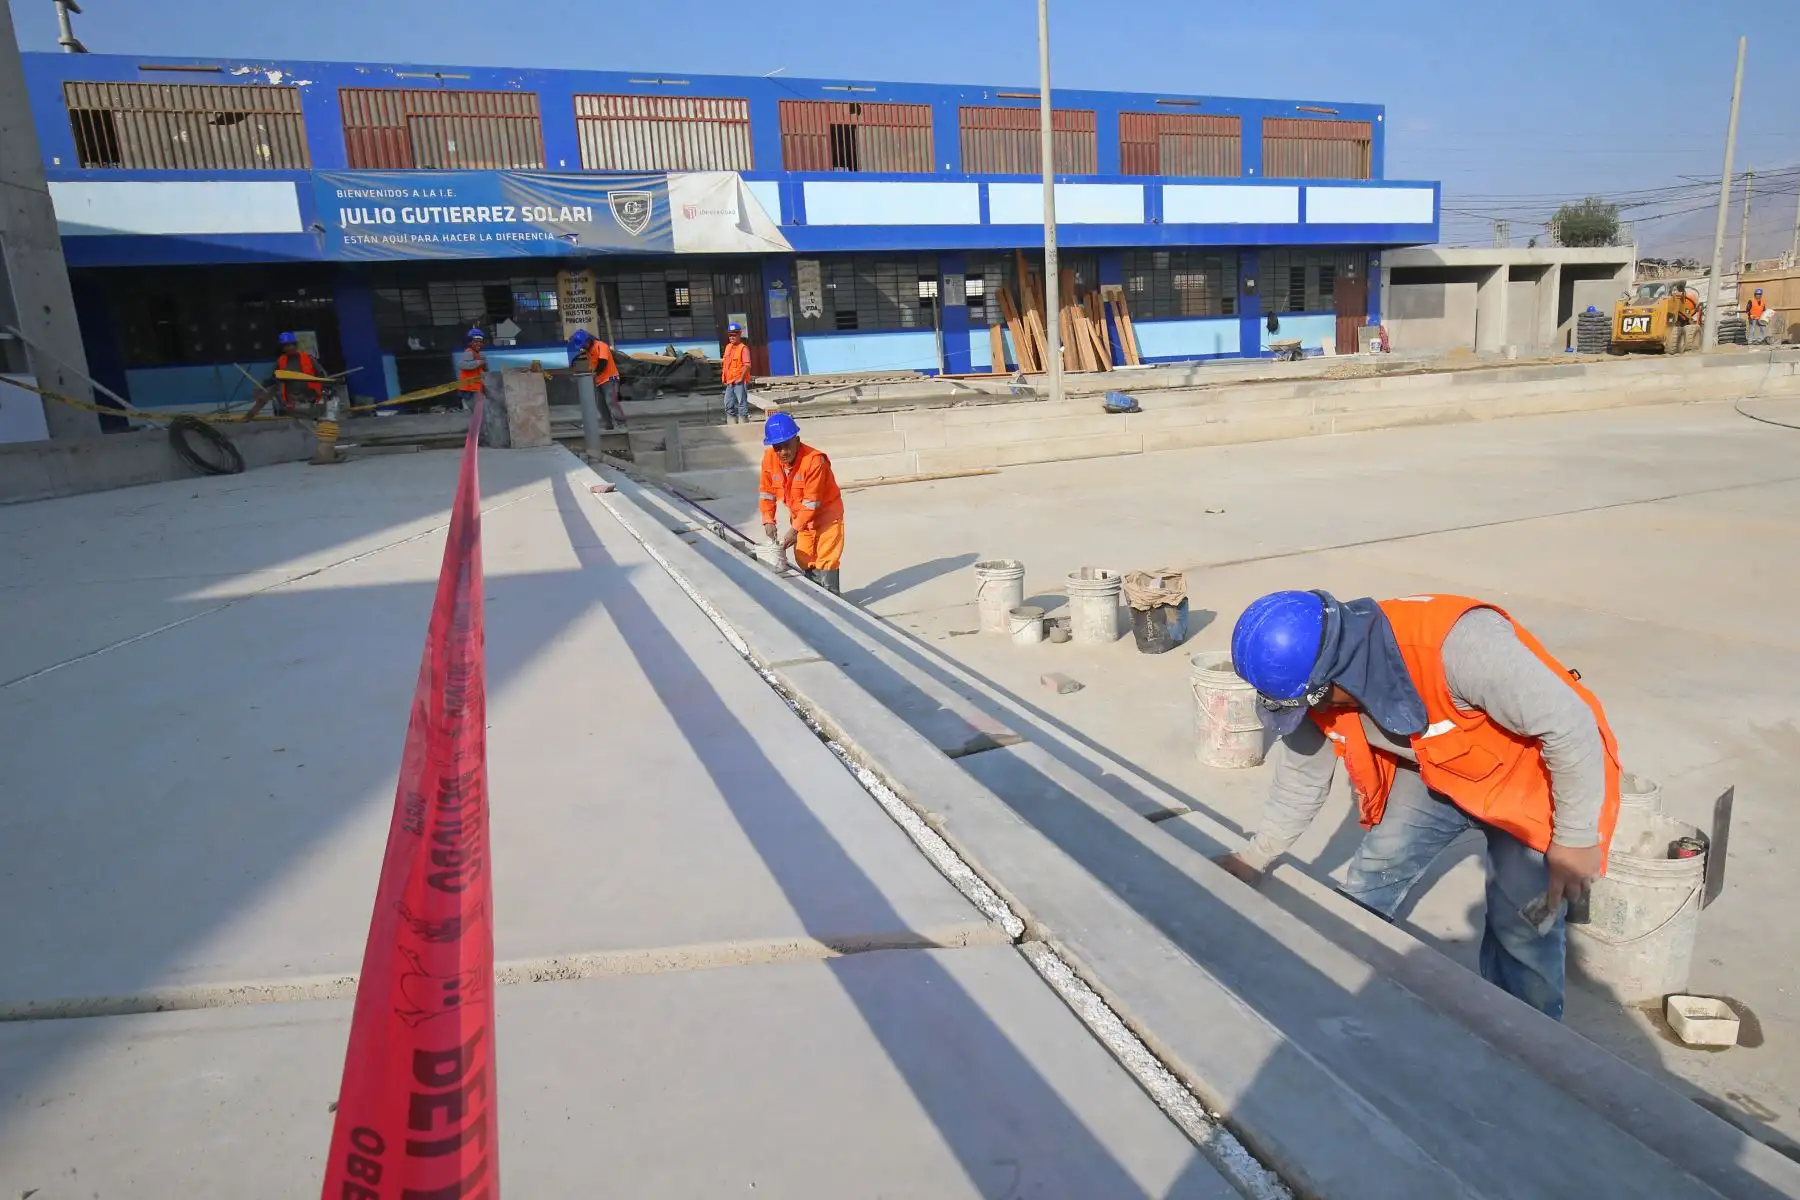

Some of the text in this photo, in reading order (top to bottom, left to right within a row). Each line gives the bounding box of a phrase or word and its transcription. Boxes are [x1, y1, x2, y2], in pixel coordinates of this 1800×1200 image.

[336, 188, 457, 198] BIENVENIDOS A LA I.E.
[339, 205, 593, 229] JULIO GUTIERREZ SOLARI
[411, 234, 440, 243] PARA
[442, 233, 477, 242] HACER
[479, 233, 493, 241] LA
[495, 232, 555, 241] DIFERENCIA
[1622, 317, 1650, 333] CAT
